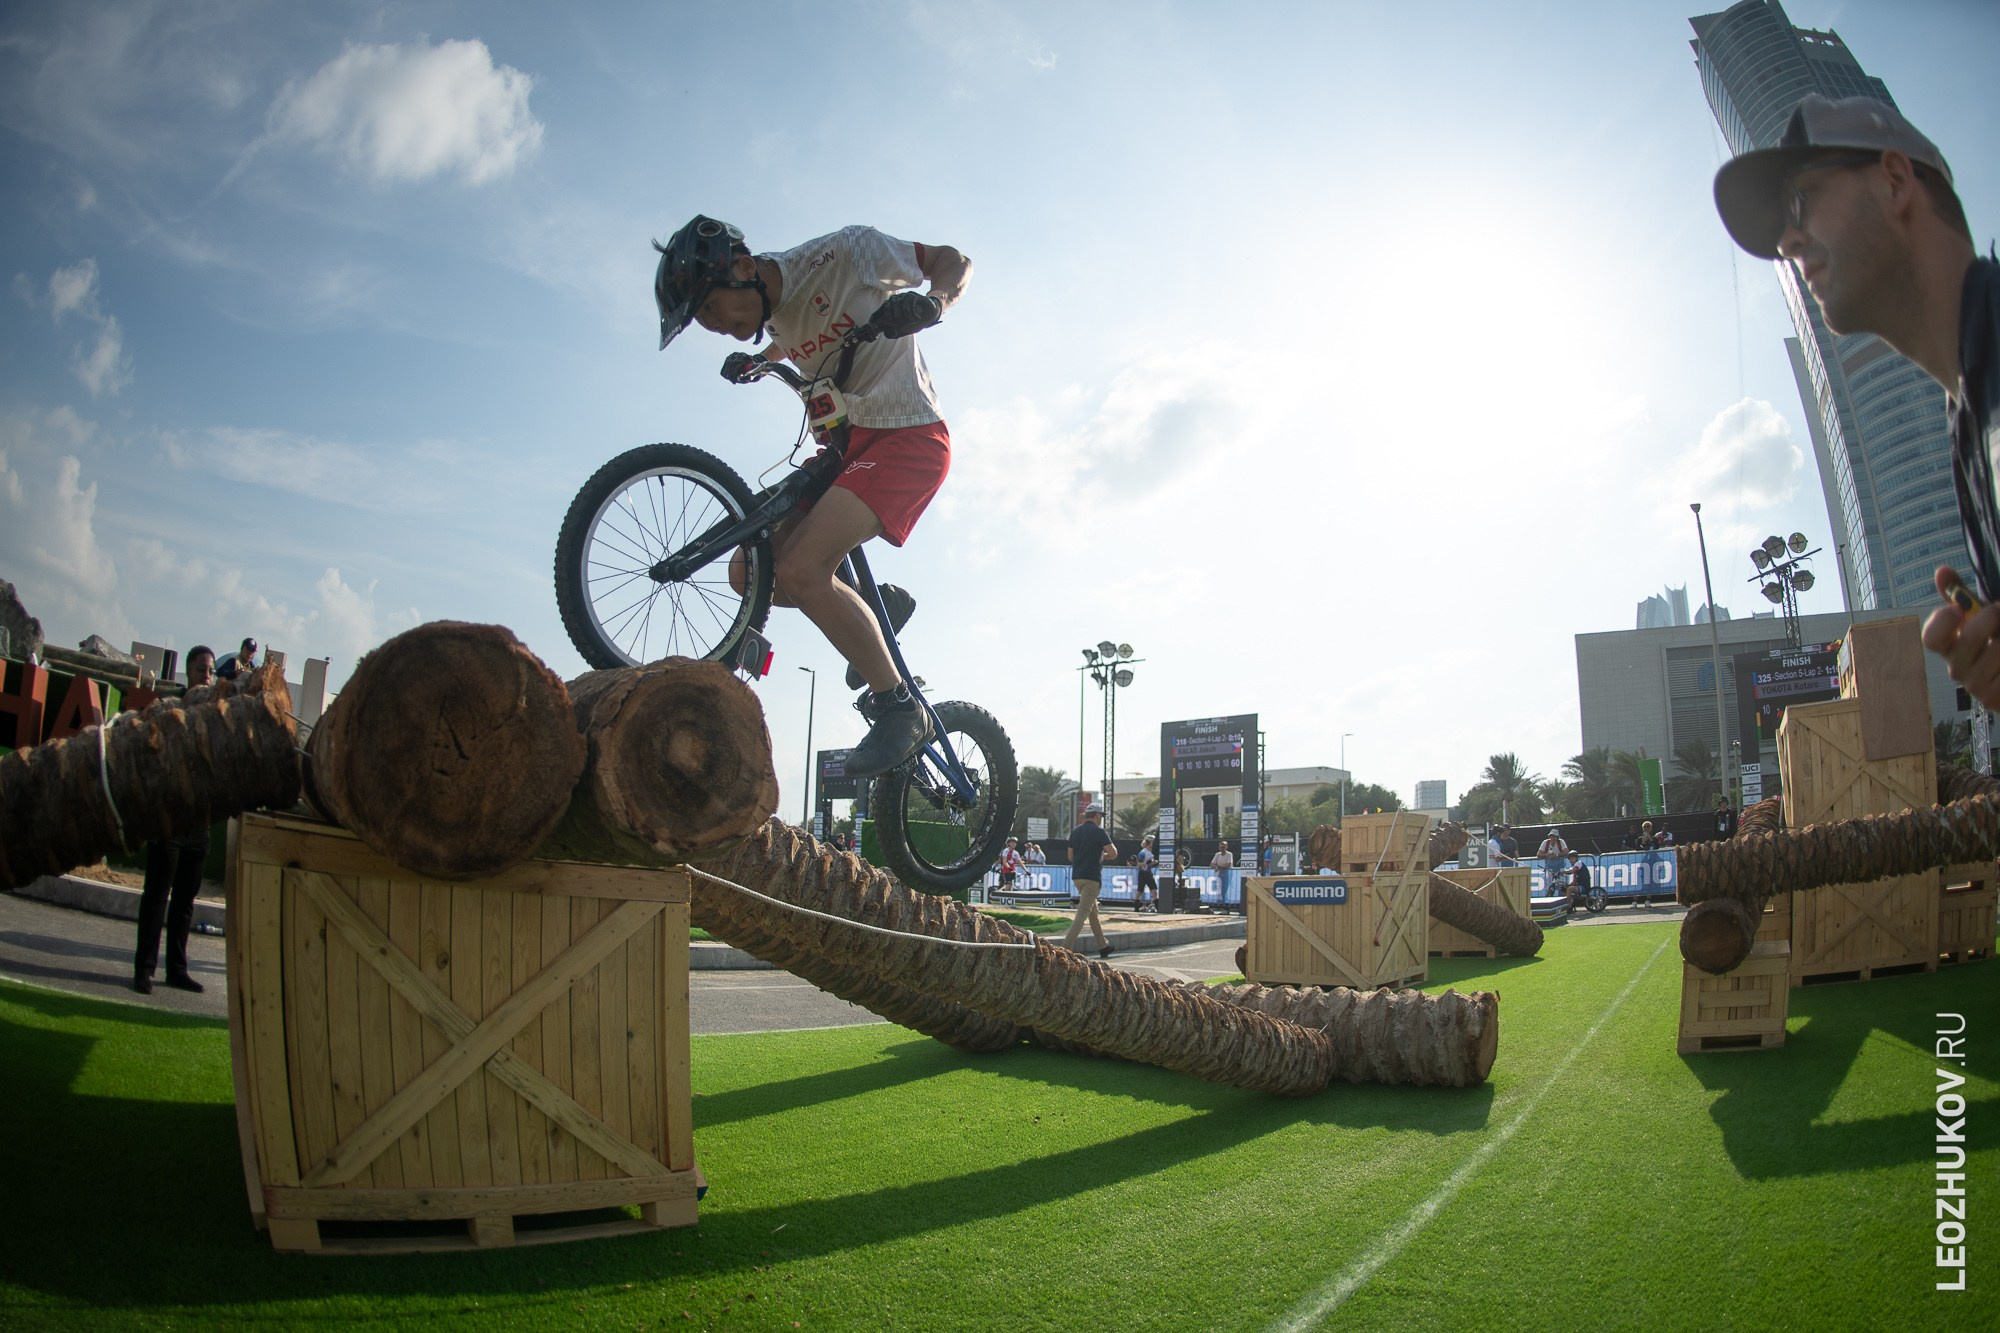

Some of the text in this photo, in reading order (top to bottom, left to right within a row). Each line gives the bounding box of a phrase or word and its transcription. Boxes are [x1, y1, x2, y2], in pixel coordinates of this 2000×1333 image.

[785, 313, 856, 361] APAN
[1783, 656, 1811, 668] FINISH
[1758, 674, 1772, 683] 325
[1761, 682, 1819, 695] YOKOTA Kotaro
[1762, 704, 1771, 715] 10
[1195, 726, 1218, 734] FINISH
[1230, 759, 1240, 767] 60
[1745, 764, 1758, 772] UCI
[1466, 847, 1480, 866] 5
[1277, 854, 1289, 871] 4
[1275, 886, 1345, 898] SHIMANO
[1001, 898, 1015, 906] UCI
[1041, 898, 1054, 906] UCI
